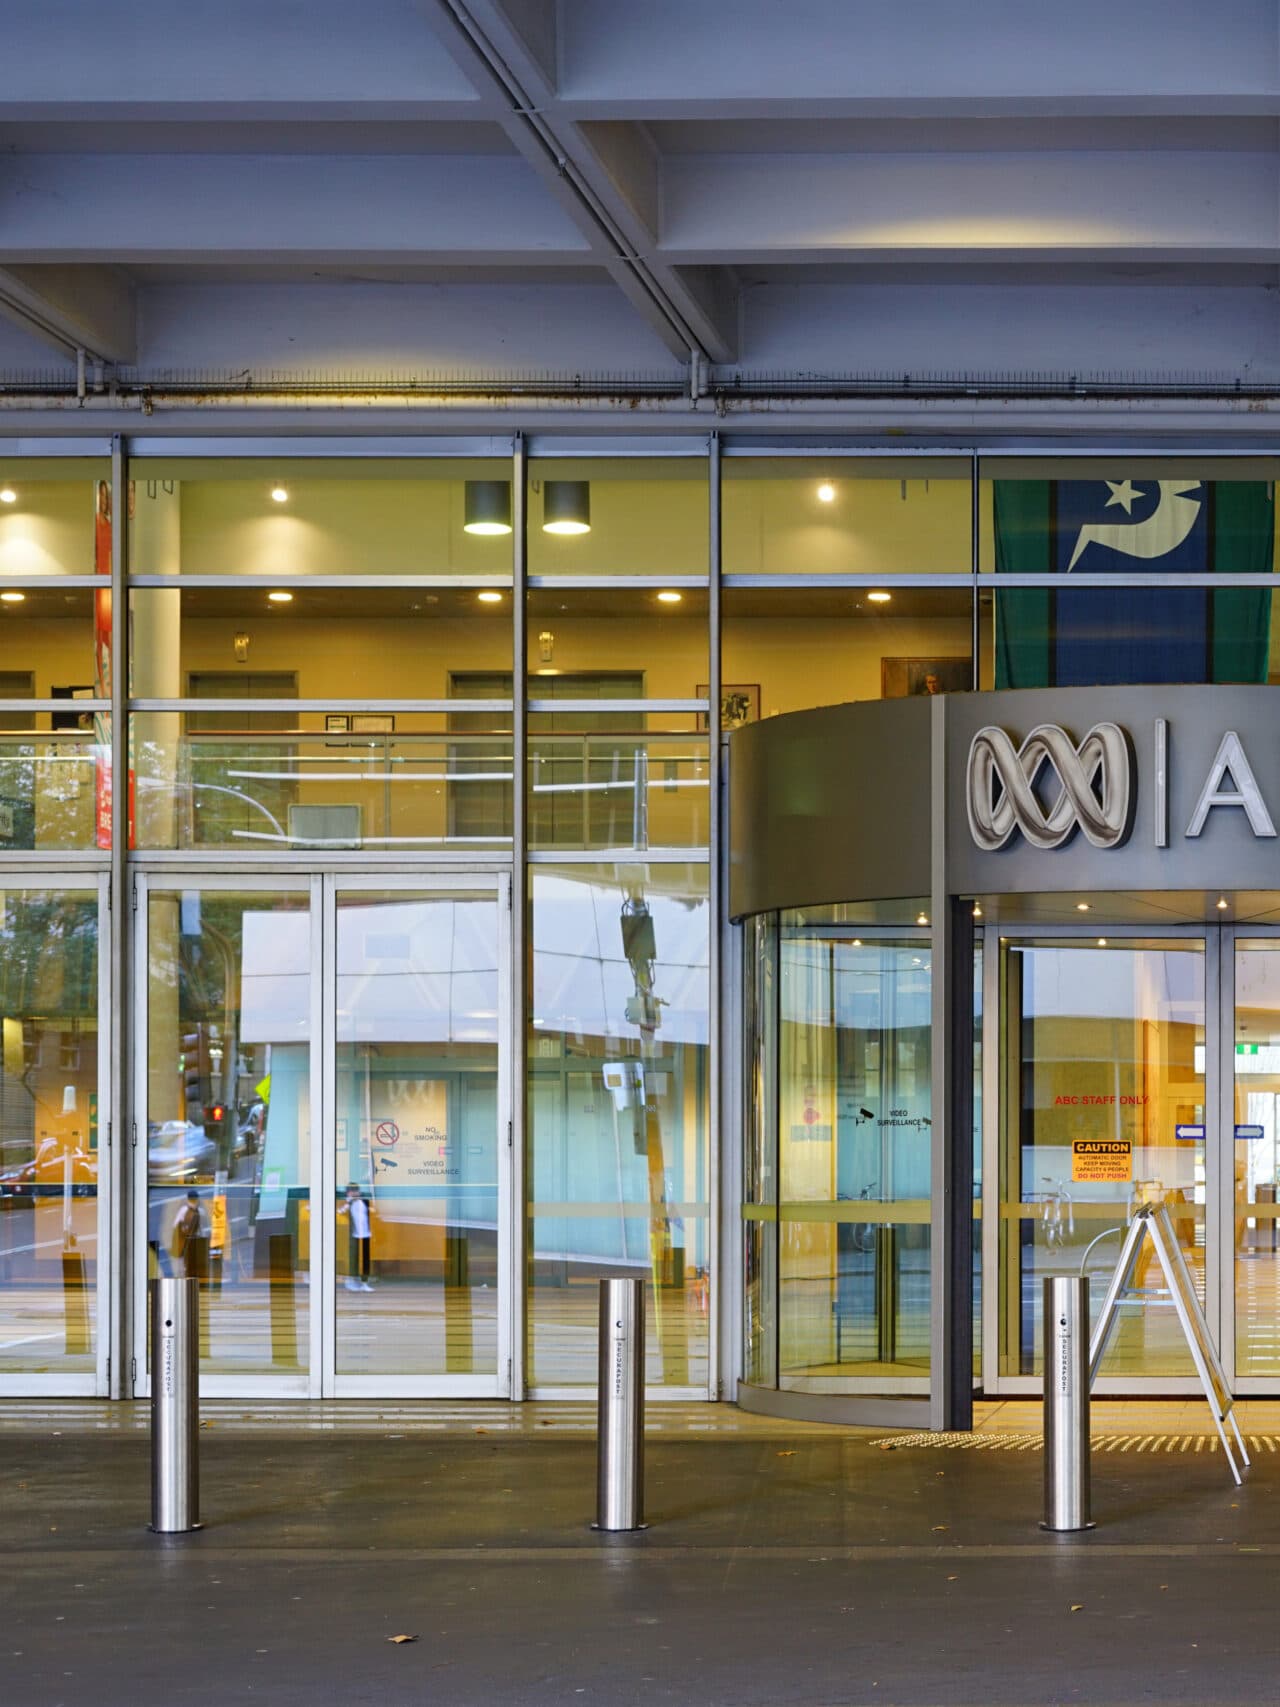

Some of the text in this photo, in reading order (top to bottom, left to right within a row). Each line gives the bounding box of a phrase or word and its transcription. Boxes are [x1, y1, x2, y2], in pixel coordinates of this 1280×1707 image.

[1055, 1095, 1150, 1105] ABC STAFF ONLY
[889, 1109, 908, 1117] VIDEO
[877, 1118, 921, 1127] SURVEILLANCE
[1076, 1143, 1129, 1152] CAUTION
